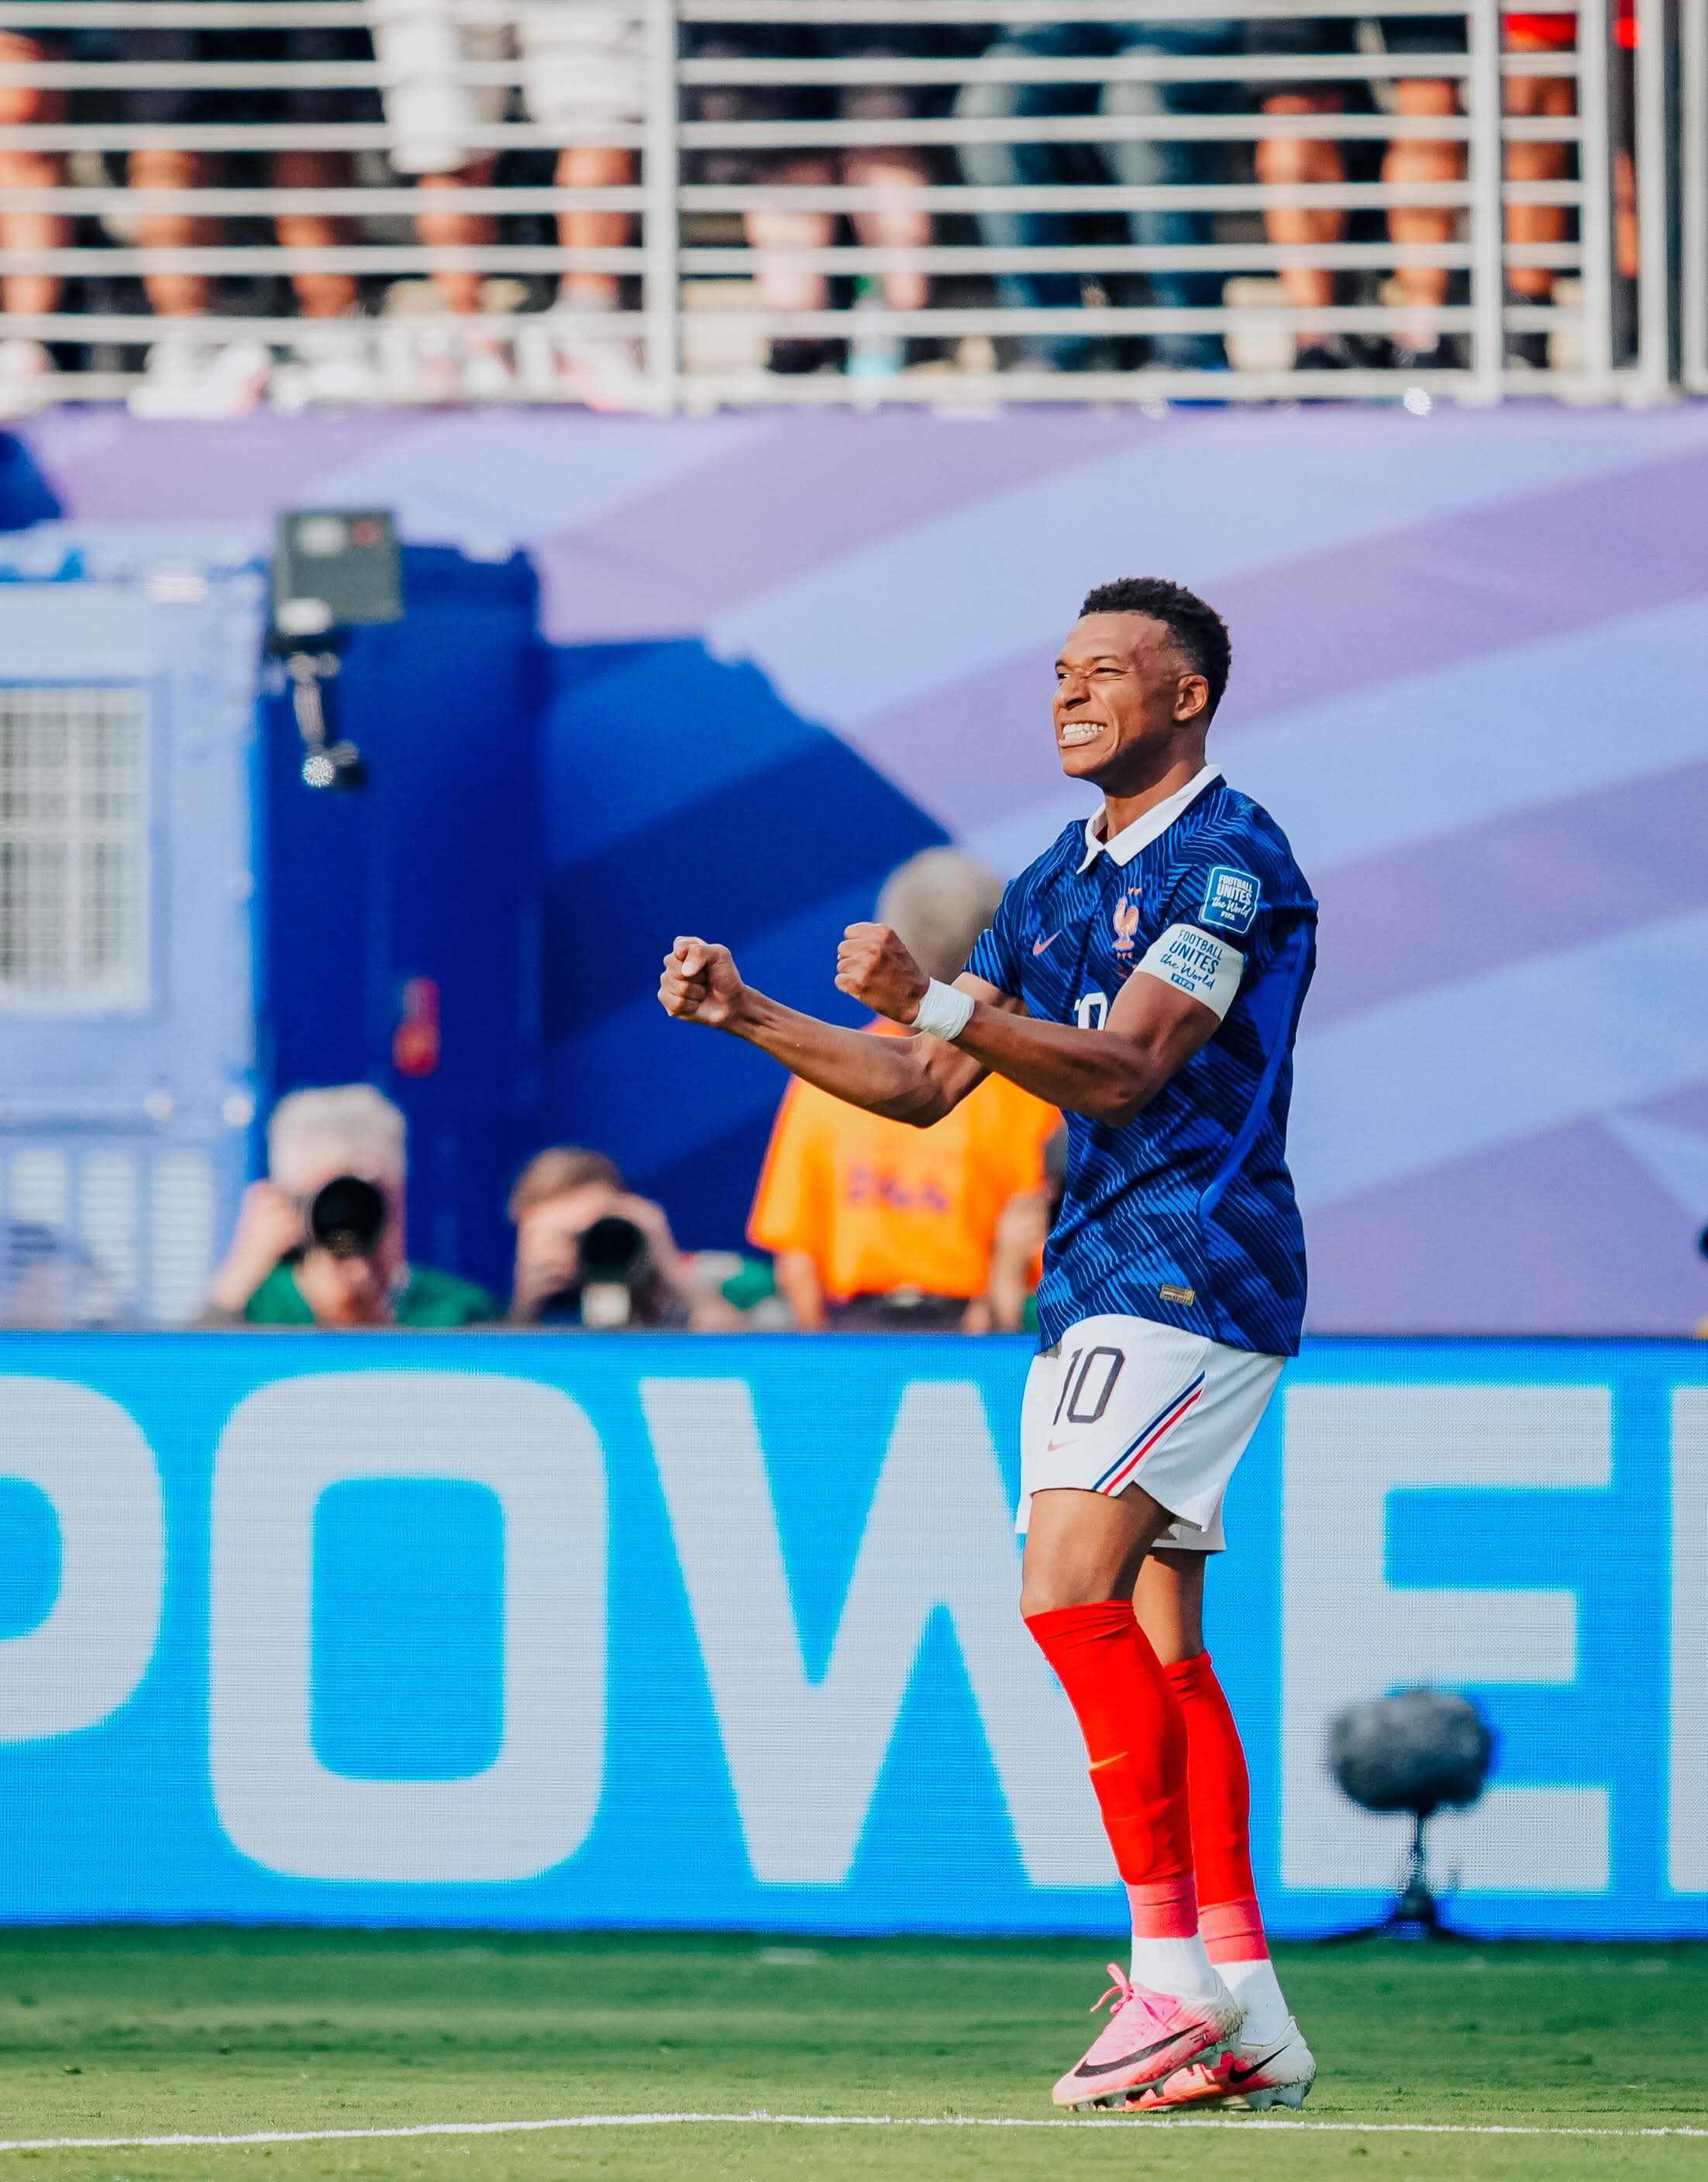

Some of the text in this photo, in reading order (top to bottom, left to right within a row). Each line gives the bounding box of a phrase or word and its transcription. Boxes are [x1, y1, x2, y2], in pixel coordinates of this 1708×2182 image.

[1217, 883, 1252, 905] UNITES
[1219, 874, 1252, 893] FOOTBALL
[1211, 897, 1252, 917] the World
[1169, 941, 1219, 974] UNITES
[1177, 929, 1223, 960] FOOTBALL
[1160, 954, 1216, 990] the World
[1052, 1346, 1126, 1426] 10
[0, 1370, 1708, 1892] OWE
